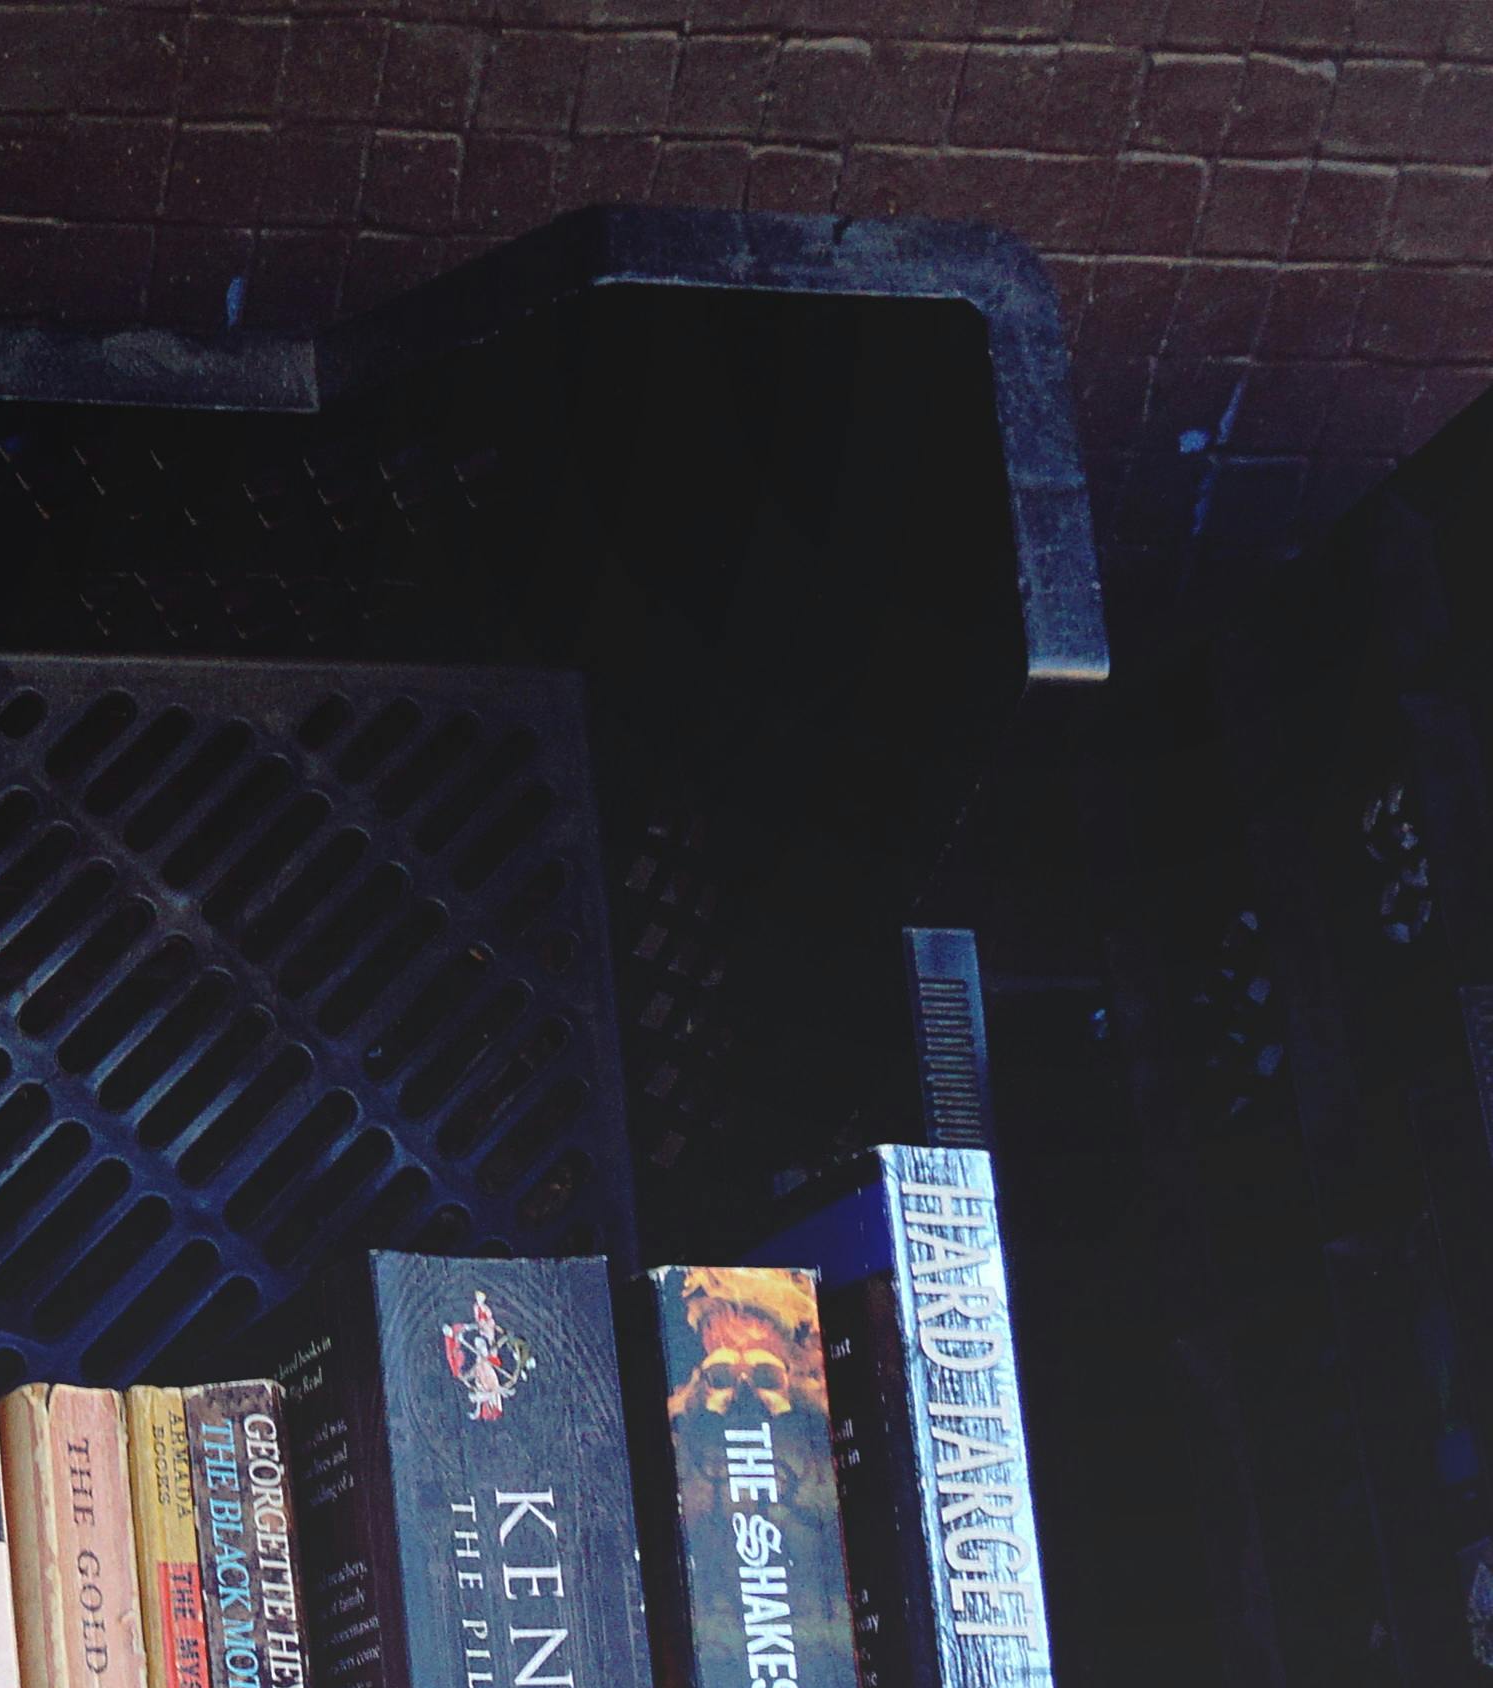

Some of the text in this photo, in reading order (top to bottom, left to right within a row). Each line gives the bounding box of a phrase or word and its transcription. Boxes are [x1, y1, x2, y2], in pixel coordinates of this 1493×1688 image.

[902, 1179, 1008, 1374] HARD
[66, 1438, 95, 1526] THE
[152, 1423, 171, 1507] BOOKS
[166, 1410, 194, 1521] ARMADA
[201, 1419, 239, 1491] THE
[724, 1421, 779, 1503] THE
[208, 1495, 252, 1613] BLACK
[244, 1413, 294, 1625] GEORGETTE
[451, 1496, 484, 1590] THE
[927, 1399, 1038, 1651] TARGET
[76, 1548, 108, 1684] GOLD
[169, 1570, 195, 1623] THE
